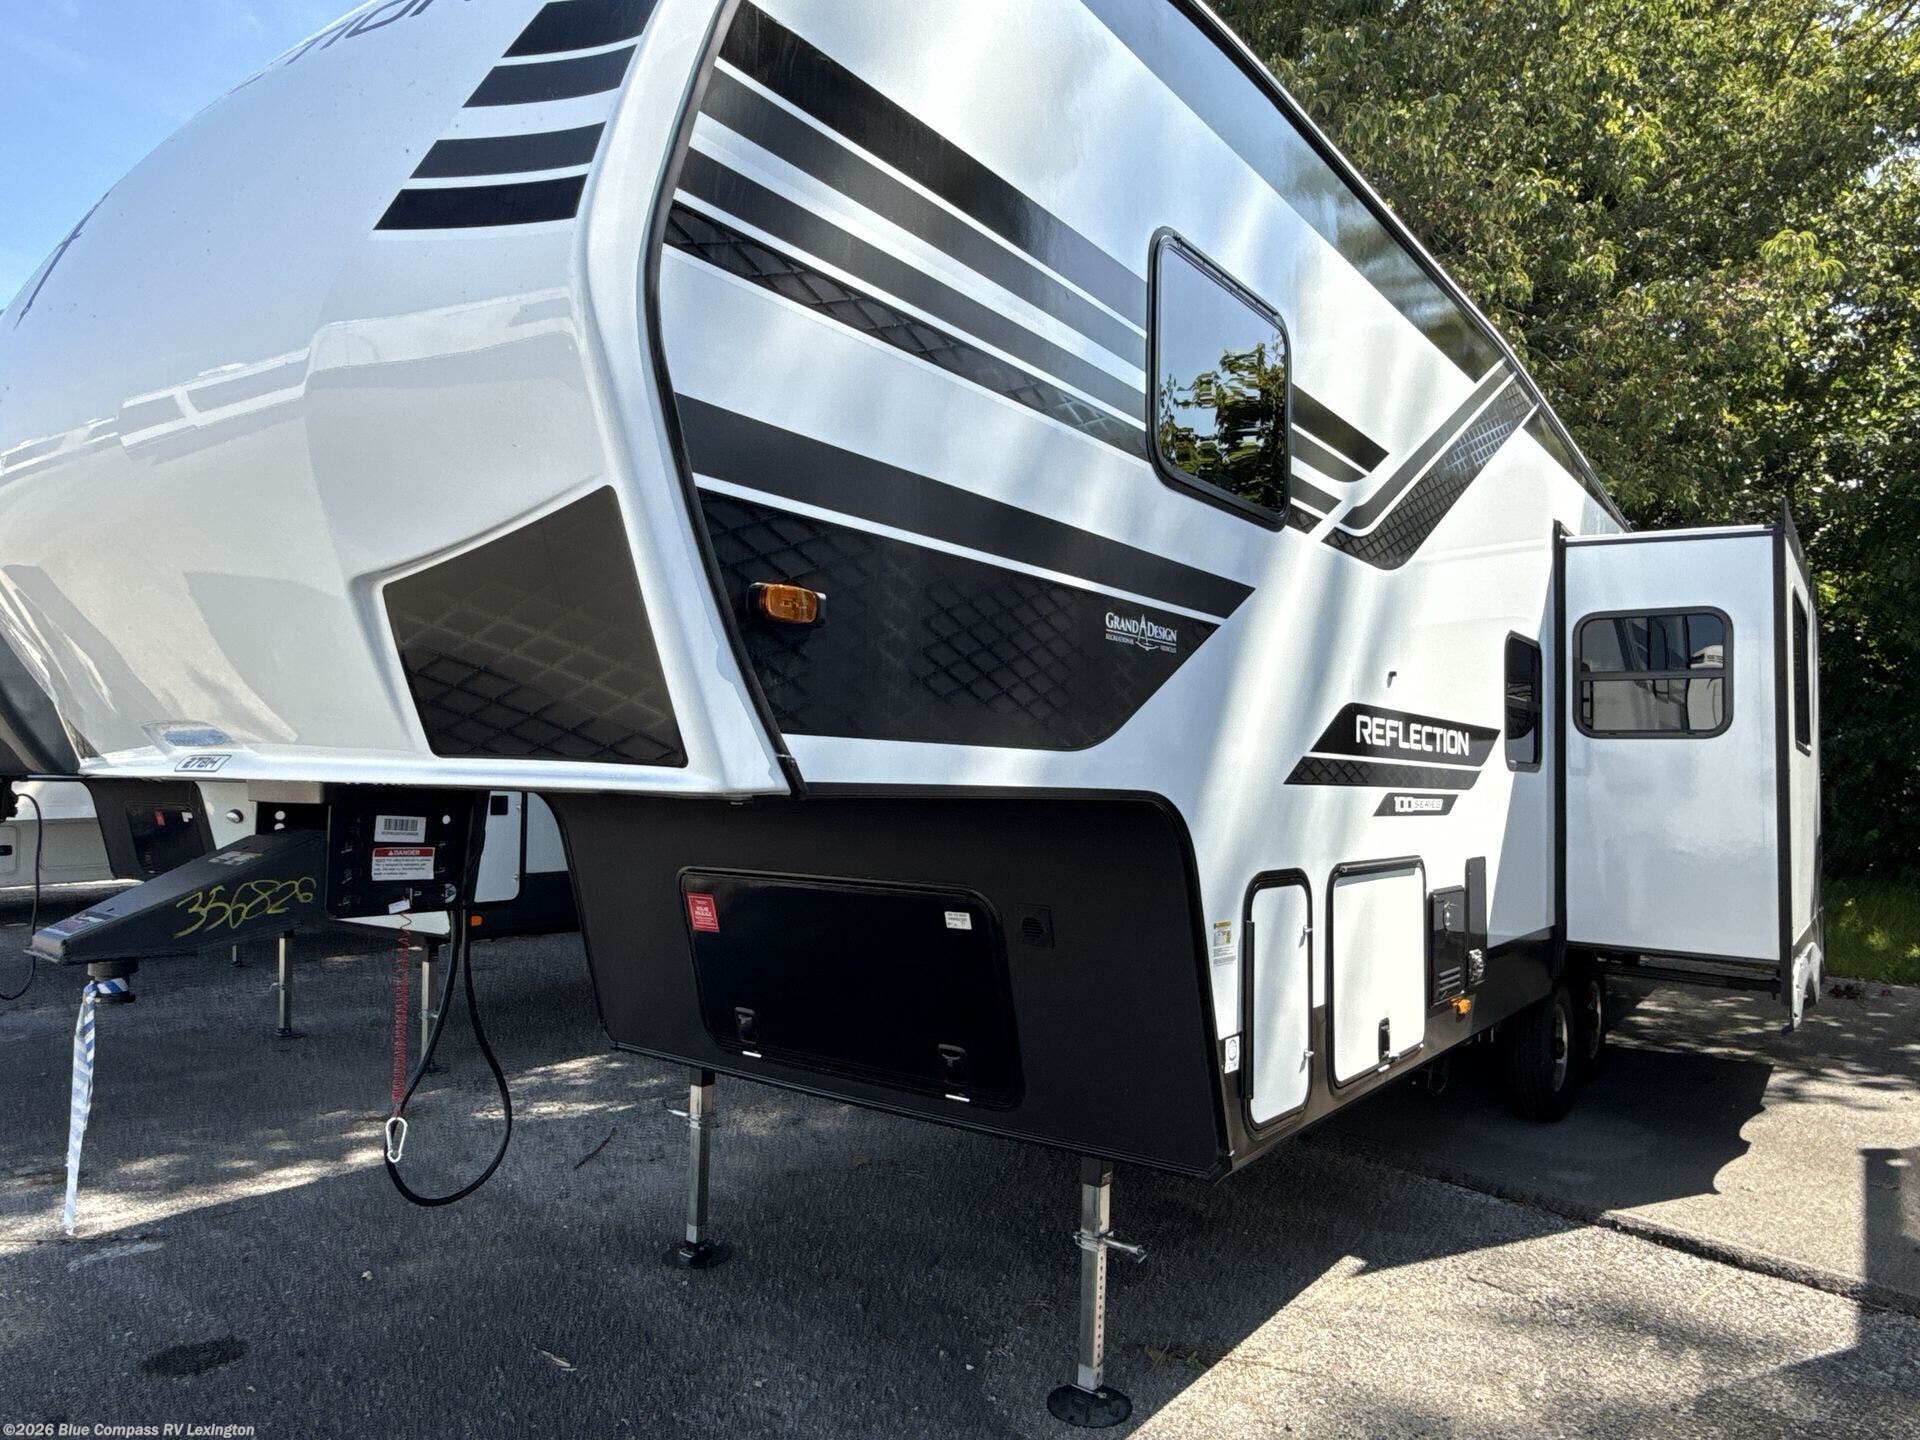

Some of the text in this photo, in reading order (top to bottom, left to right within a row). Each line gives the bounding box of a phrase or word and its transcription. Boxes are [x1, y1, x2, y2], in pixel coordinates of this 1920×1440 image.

[1105, 612, 1177, 642] GRAND DESIGN
[1356, 714, 1469, 756] REFLECTION
[1394, 796, 1441, 812] 100 SERIES
[174, 876, 317, 938] 356826
